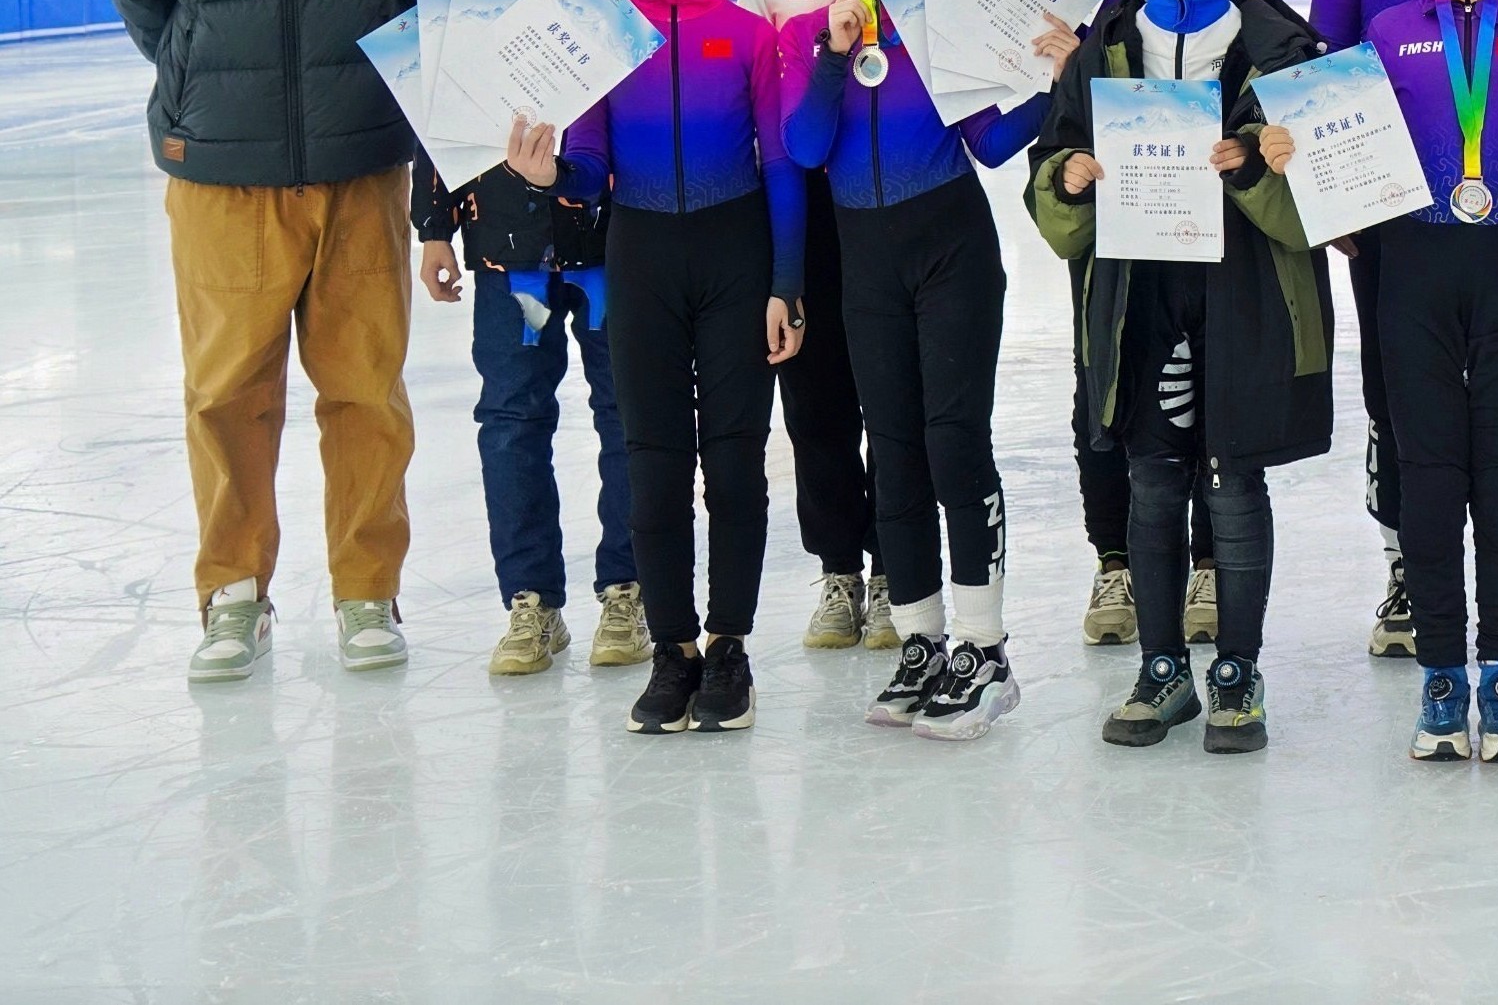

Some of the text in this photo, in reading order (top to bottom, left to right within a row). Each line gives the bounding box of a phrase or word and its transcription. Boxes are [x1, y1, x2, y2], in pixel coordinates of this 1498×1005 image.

[547, 22, 591, 66] 获奖证书
[1398, 40, 1444, 57] FMSH
[1313, 112, 1365, 141] 获奖证书
[1133, 143, 1186, 157] 获奖证书
